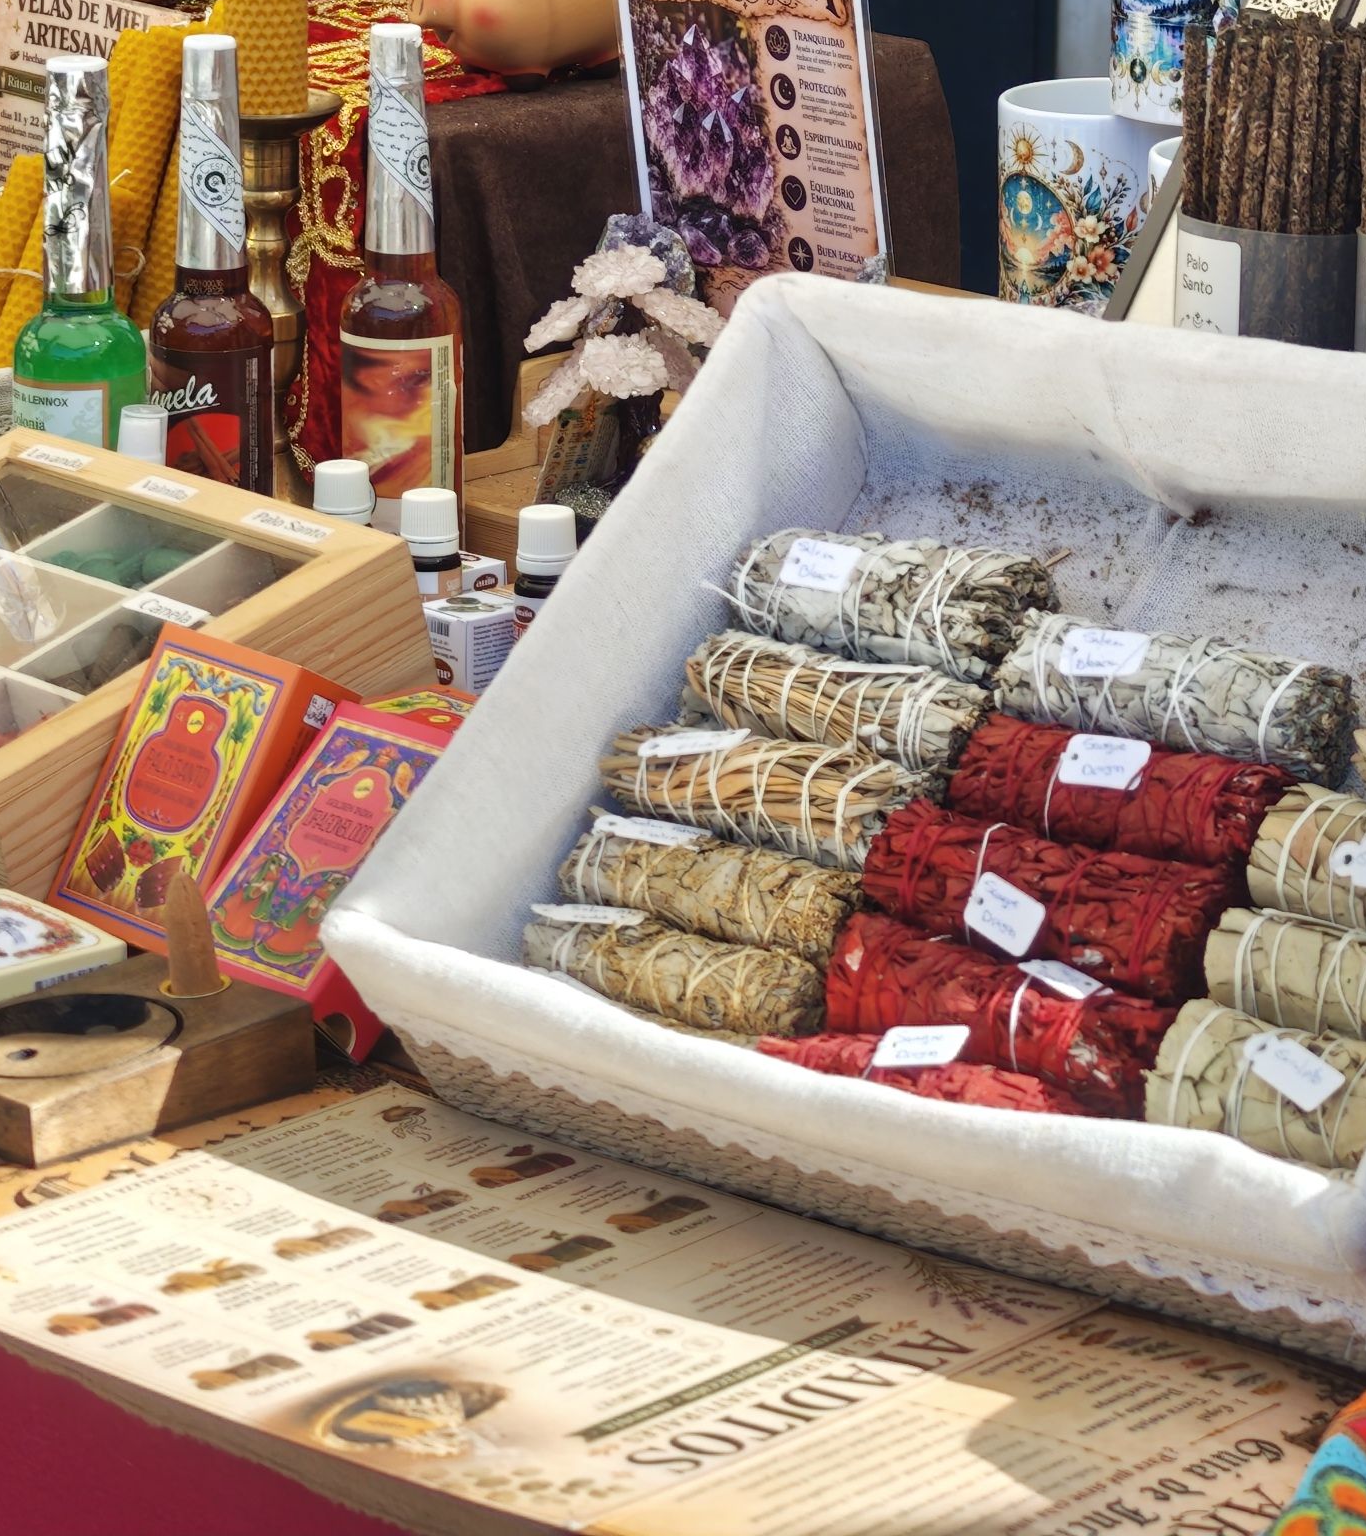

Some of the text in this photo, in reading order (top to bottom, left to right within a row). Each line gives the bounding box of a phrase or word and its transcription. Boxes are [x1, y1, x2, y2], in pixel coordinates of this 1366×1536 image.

[78, 0, 100, 24] DE
[793, 30, 845, 48] TRANQUILIDAD
[7, 77, 32, 91] Ritual
[799, 79, 847, 97] PROTECCIÓN
[14, 112, 22, 123] 11
[29, 117, 39, 130] 22
[804, 130, 863, 152] ESPIRITUALIDAD
[810, 180, 855, 200] EQUILIBRIO
[811, 192, 856, 212] EMOCIONAL
[1186, 252, 1209, 273] Palo
[1182, 273, 1214, 296] Santo
[28, 395, 68, 408] LENNOX
[625, 1330, 975, 1476] ATADITOS
[1136, 1438, 1284, 1510] Guía de
